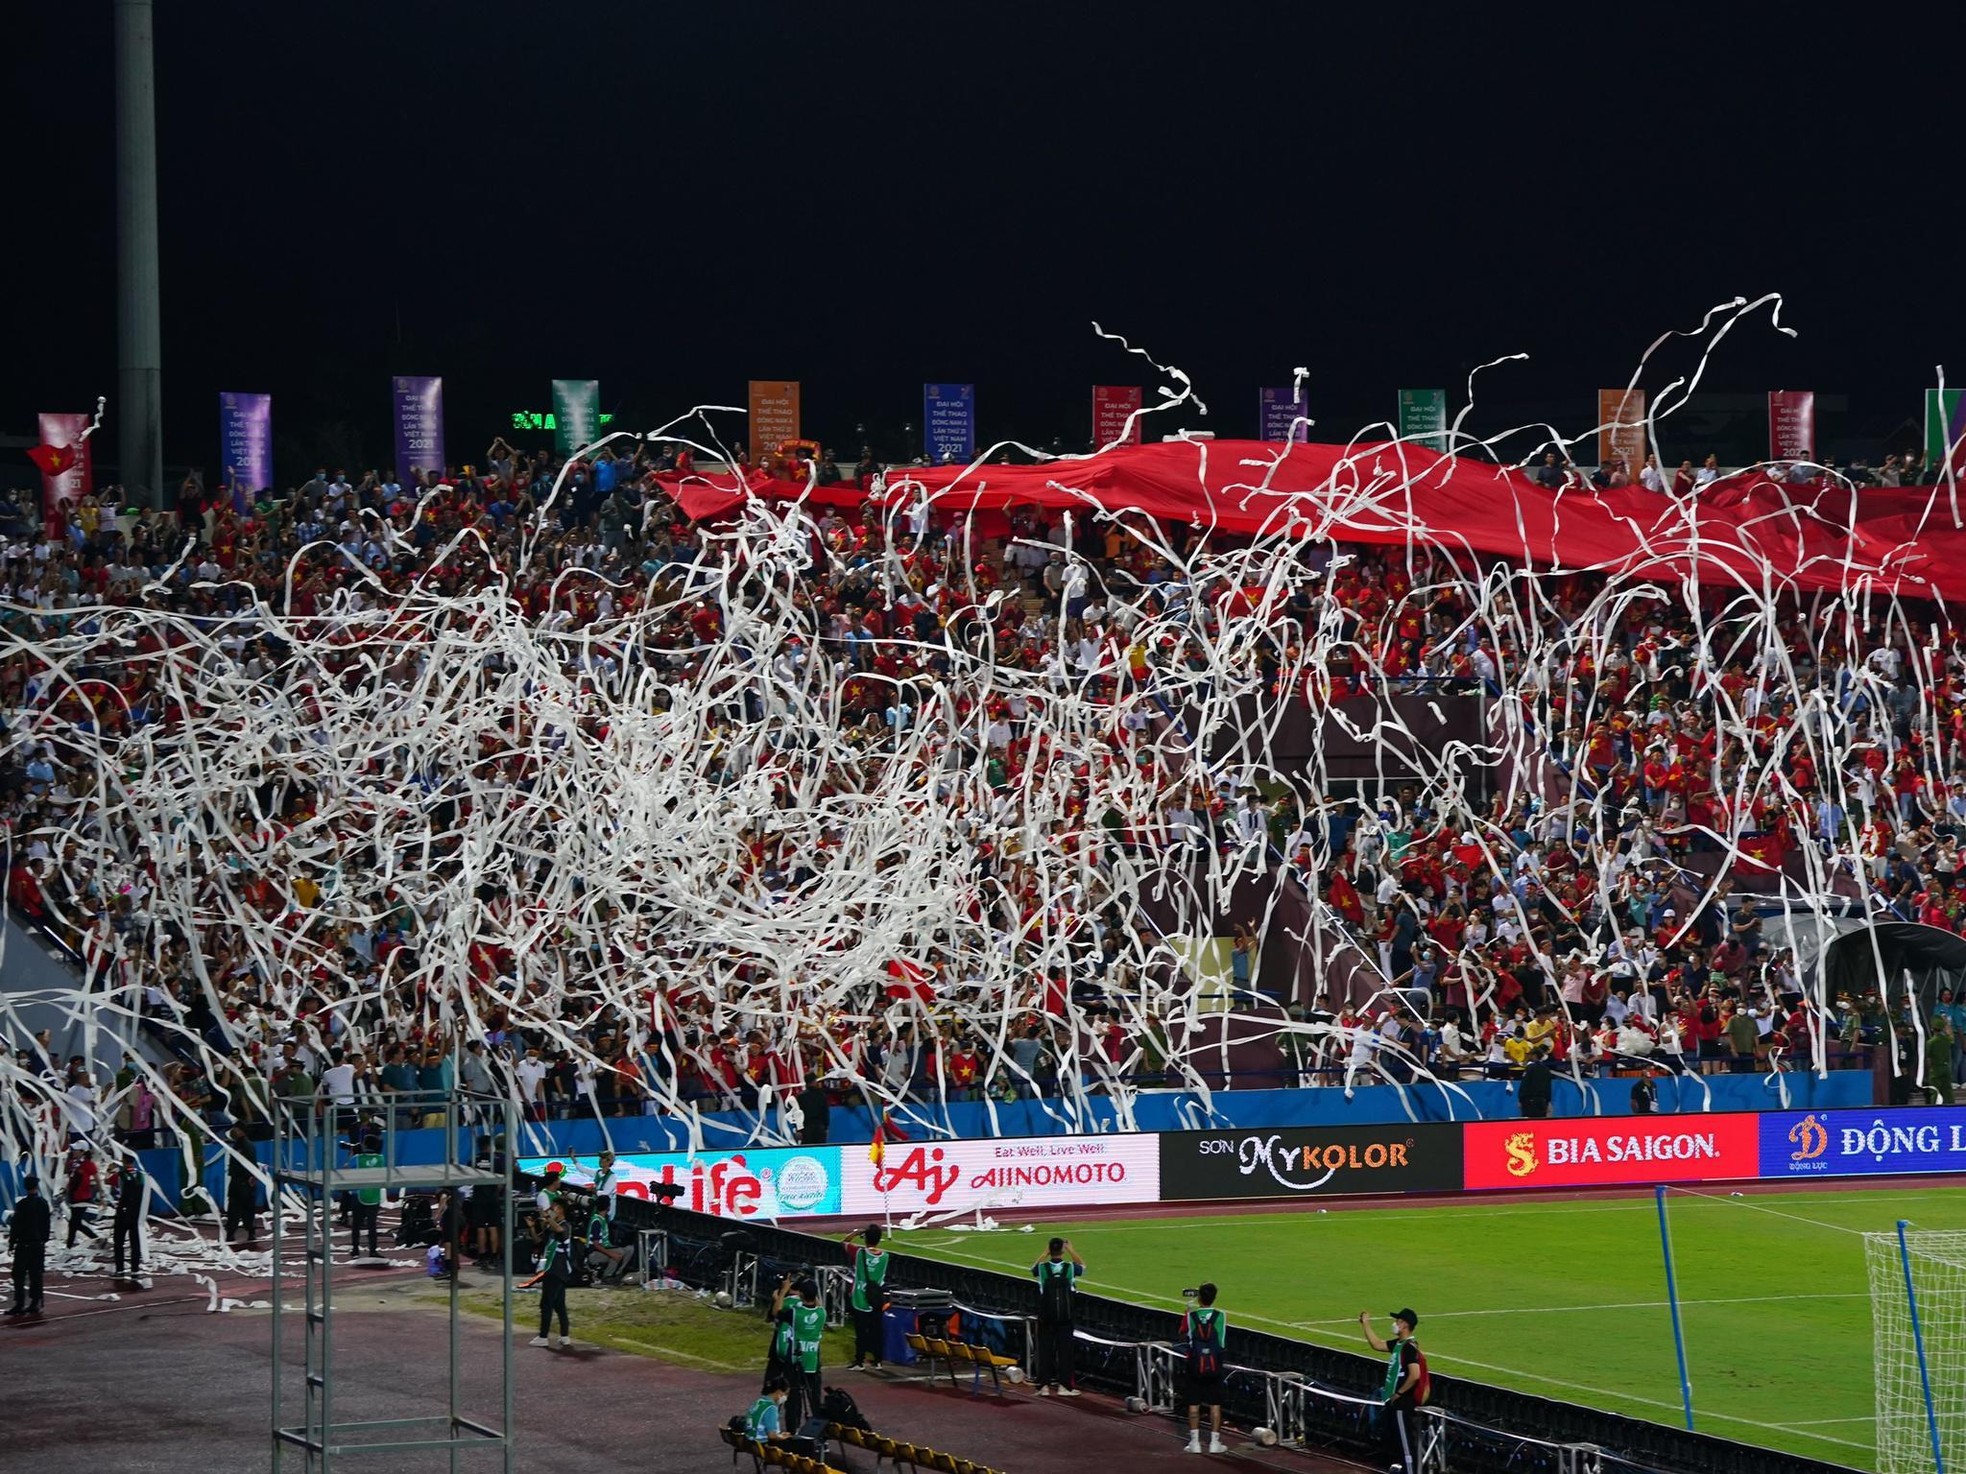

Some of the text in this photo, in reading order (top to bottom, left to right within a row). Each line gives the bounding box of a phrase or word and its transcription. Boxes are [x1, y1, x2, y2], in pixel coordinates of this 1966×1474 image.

[938, 443, 963, 453] 2021
[995, 1147, 1014, 1158] Eat
[1050, 1144, 1075, 1155] Live
[1547, 1133, 1714, 1164] BIA SAIGON
[1840, 1119, 1942, 1163] ĐỘNG
